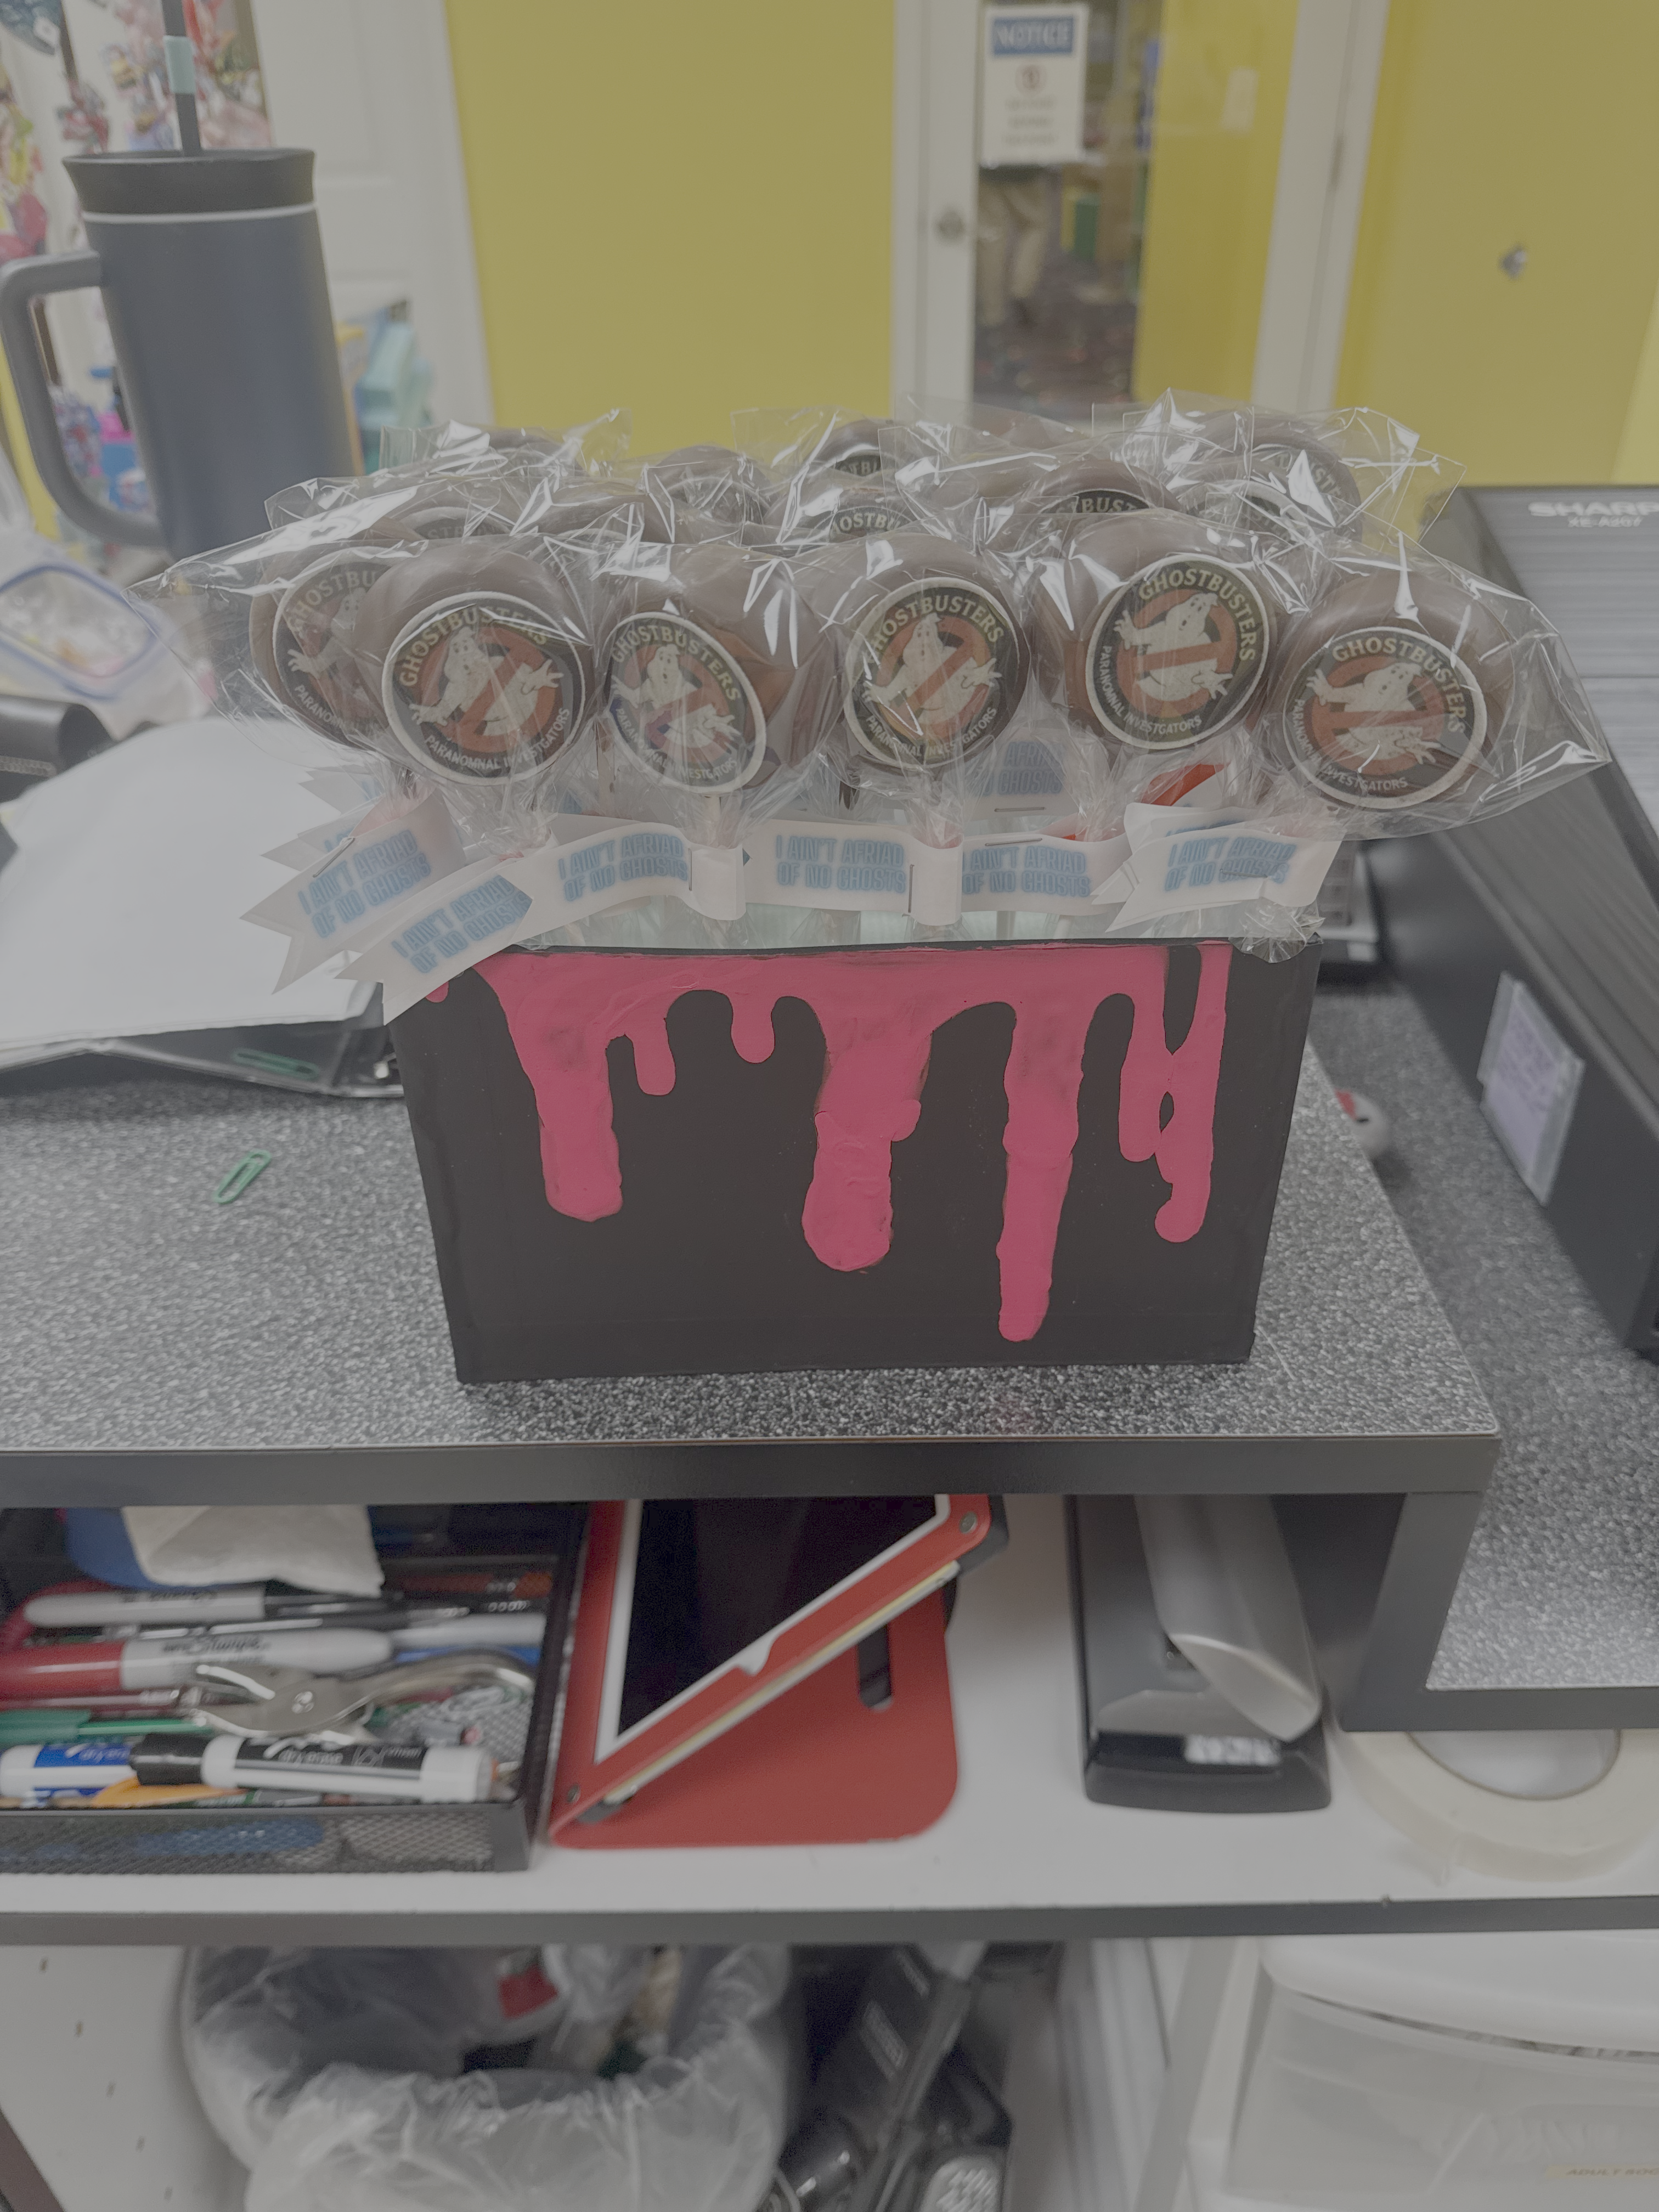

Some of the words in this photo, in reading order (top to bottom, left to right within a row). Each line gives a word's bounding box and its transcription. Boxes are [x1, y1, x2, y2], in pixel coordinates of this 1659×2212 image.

[1528, 501, 1659, 517] SHARP
[866, 594, 1004, 663] HOSTBUSTERS
[1138, 568, 1257, 662] GHOSTBUSTERS
[611, 625, 741, 701] GHOSTBUSTERS
[1099, 645, 1126, 716] PARANOMNAL
[1332, 637, 1466, 733] GHOSTBUSTERS
[998, 769, 1063, 795] GHOSTS
[298, 890, 312, 915] I
[308, 860, 354, 909] AIN'T
[353, 830, 417, 879] AFRIAD
[558, 858, 567, 880] I
[570, 840, 617, 876] AIN'T
[620, 833, 684, 859] AFRIAD
[775, 834, 782, 859] I
[787, 836, 838, 863] AIN'T
[841, 839, 905, 867] AFRIAD
[971, 847, 1019, 871] AIN'T
[1025, 845, 1086, 874] AFRIAD
[1168, 844, 1177, 867] I
[1178, 837, 1229, 865] AIN'T
[1227, 837, 1297, 863] AFRIAD
[312, 906, 336, 939] OF
[335, 889, 365, 924] NO
[362, 852, 432, 906] GHOSTS
[563, 875, 586, 902] OF
[589, 864, 616, 893] NO
[619, 856, 688, 882] GHOSTS
[777, 861, 800, 886] OF
[805, 864, 832, 889] NO
[837, 866, 906, 894] GHOSTS
[962, 872, 984, 895] OF
[989, 871, 1017, 893] NO
[1022, 870, 1091, 897] GHOSTS
[1164, 866, 1188, 891] OF
[1189, 861, 1216, 887] NO
[391, 939, 409, 958] I
[402, 908, 454, 951] AIN'T
[450, 874, 516, 922] AFRIAD
[410, 946, 438, 973] OF
[433, 930, 469, 958] NO
[463, 890, 533, 941] GHOSTS
